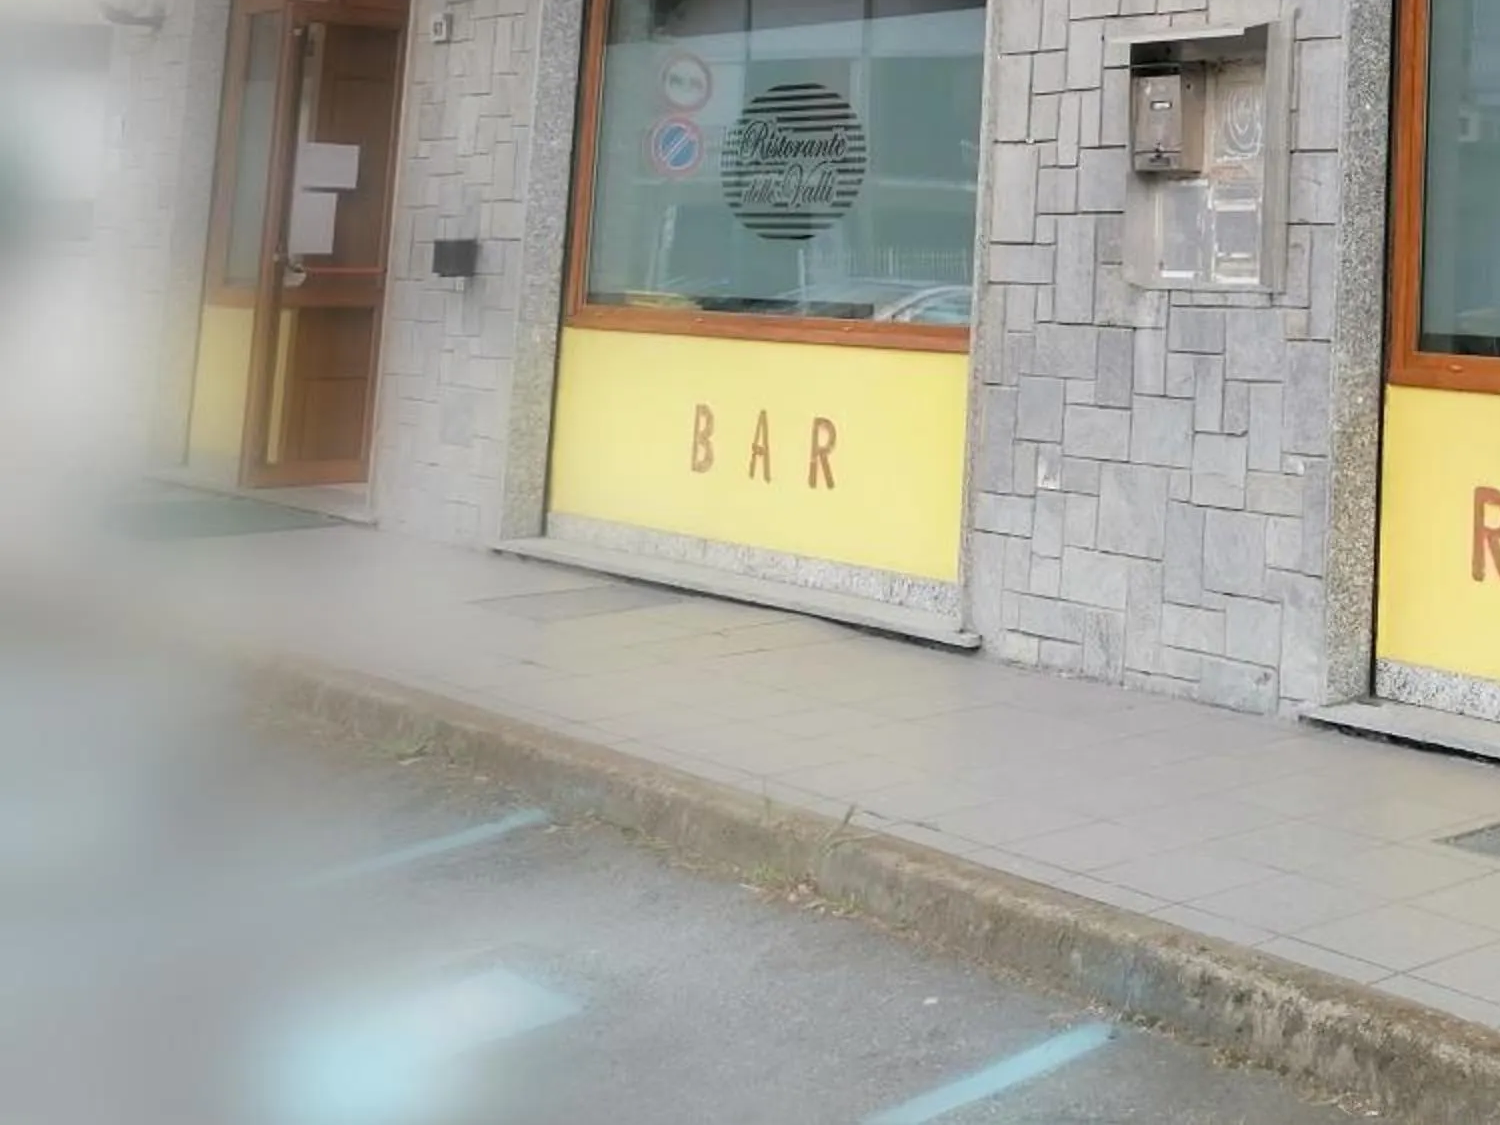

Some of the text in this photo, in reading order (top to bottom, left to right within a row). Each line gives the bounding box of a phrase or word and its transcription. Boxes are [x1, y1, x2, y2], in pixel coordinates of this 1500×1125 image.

[741, 120, 846, 159] Ristorante
[782, 161, 835, 205] Valli
[691, 403, 837, 489] BAR
